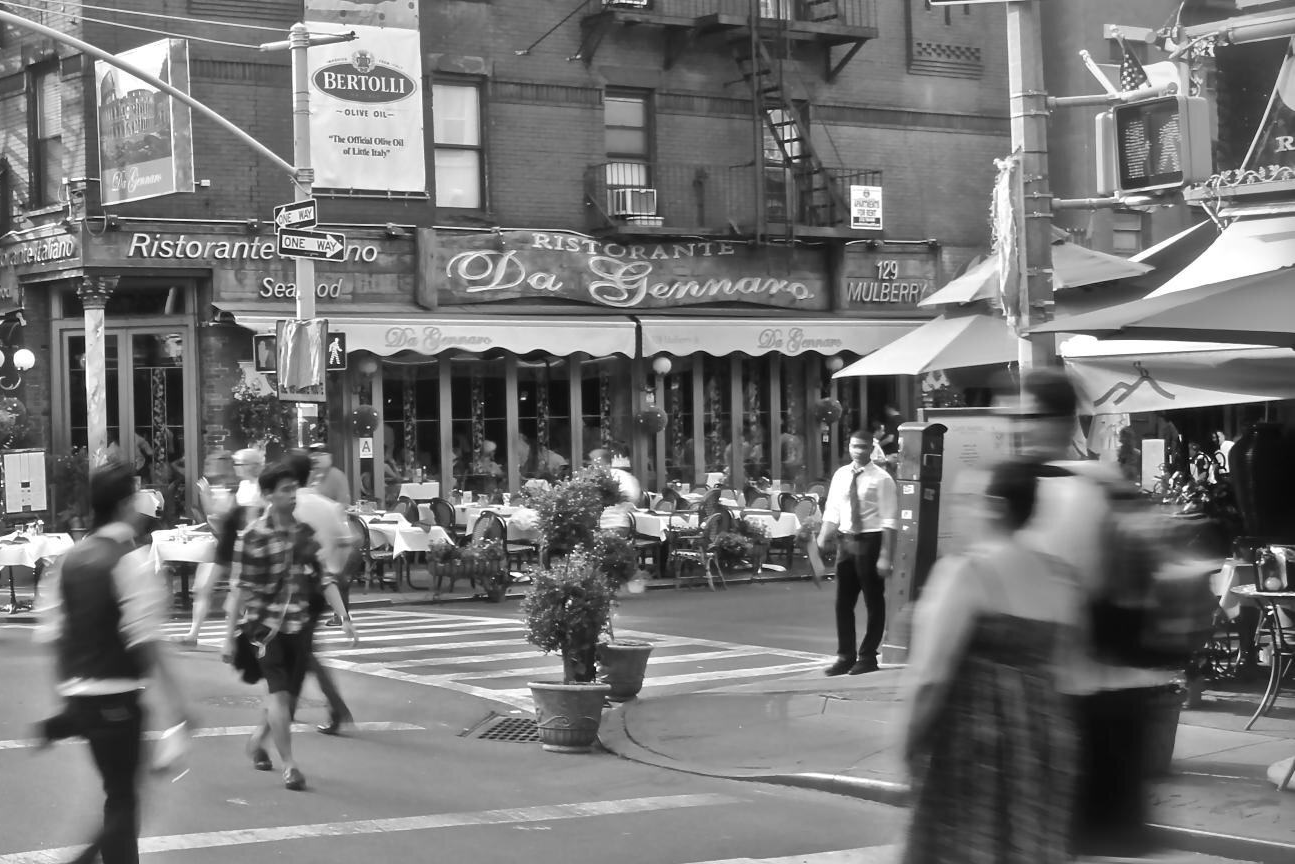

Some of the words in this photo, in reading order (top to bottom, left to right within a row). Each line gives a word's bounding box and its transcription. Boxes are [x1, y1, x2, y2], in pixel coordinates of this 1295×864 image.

[323, 71, 405, 94] BERTOLLI
[344, 108, 369, 118] OLIVE
[373, 110, 388, 119] OIL
[347, 135, 373, 146] Official
[374, 137, 391, 147] Olive
[393, 138, 405, 147] Oil
[343, 147, 351, 156] of
[353, 147, 370, 157] Little
[278, 212, 292, 225] ONE
[298, 208, 313, 221] WAY
[128, 232, 274, 260] Ristorante
[284, 236, 305, 249] ONE
[317, 240, 337, 252] WAY
[530, 232, 735, 260] RISTORANTE
[446, 249, 565, 293] Da
[587, 255, 816, 308] Gennaro
[877, 260, 898, 280] 129
[260, 277, 343, 298] Seaod
[847, 282, 928, 303] MULBERRY
[385, 326, 418, 348] Da
[423, 326, 493, 352] Gennaro
[757, 328, 783, 349] Da
[787, 327, 843, 353] Gennaro
[361, 440, 371, 453] A
